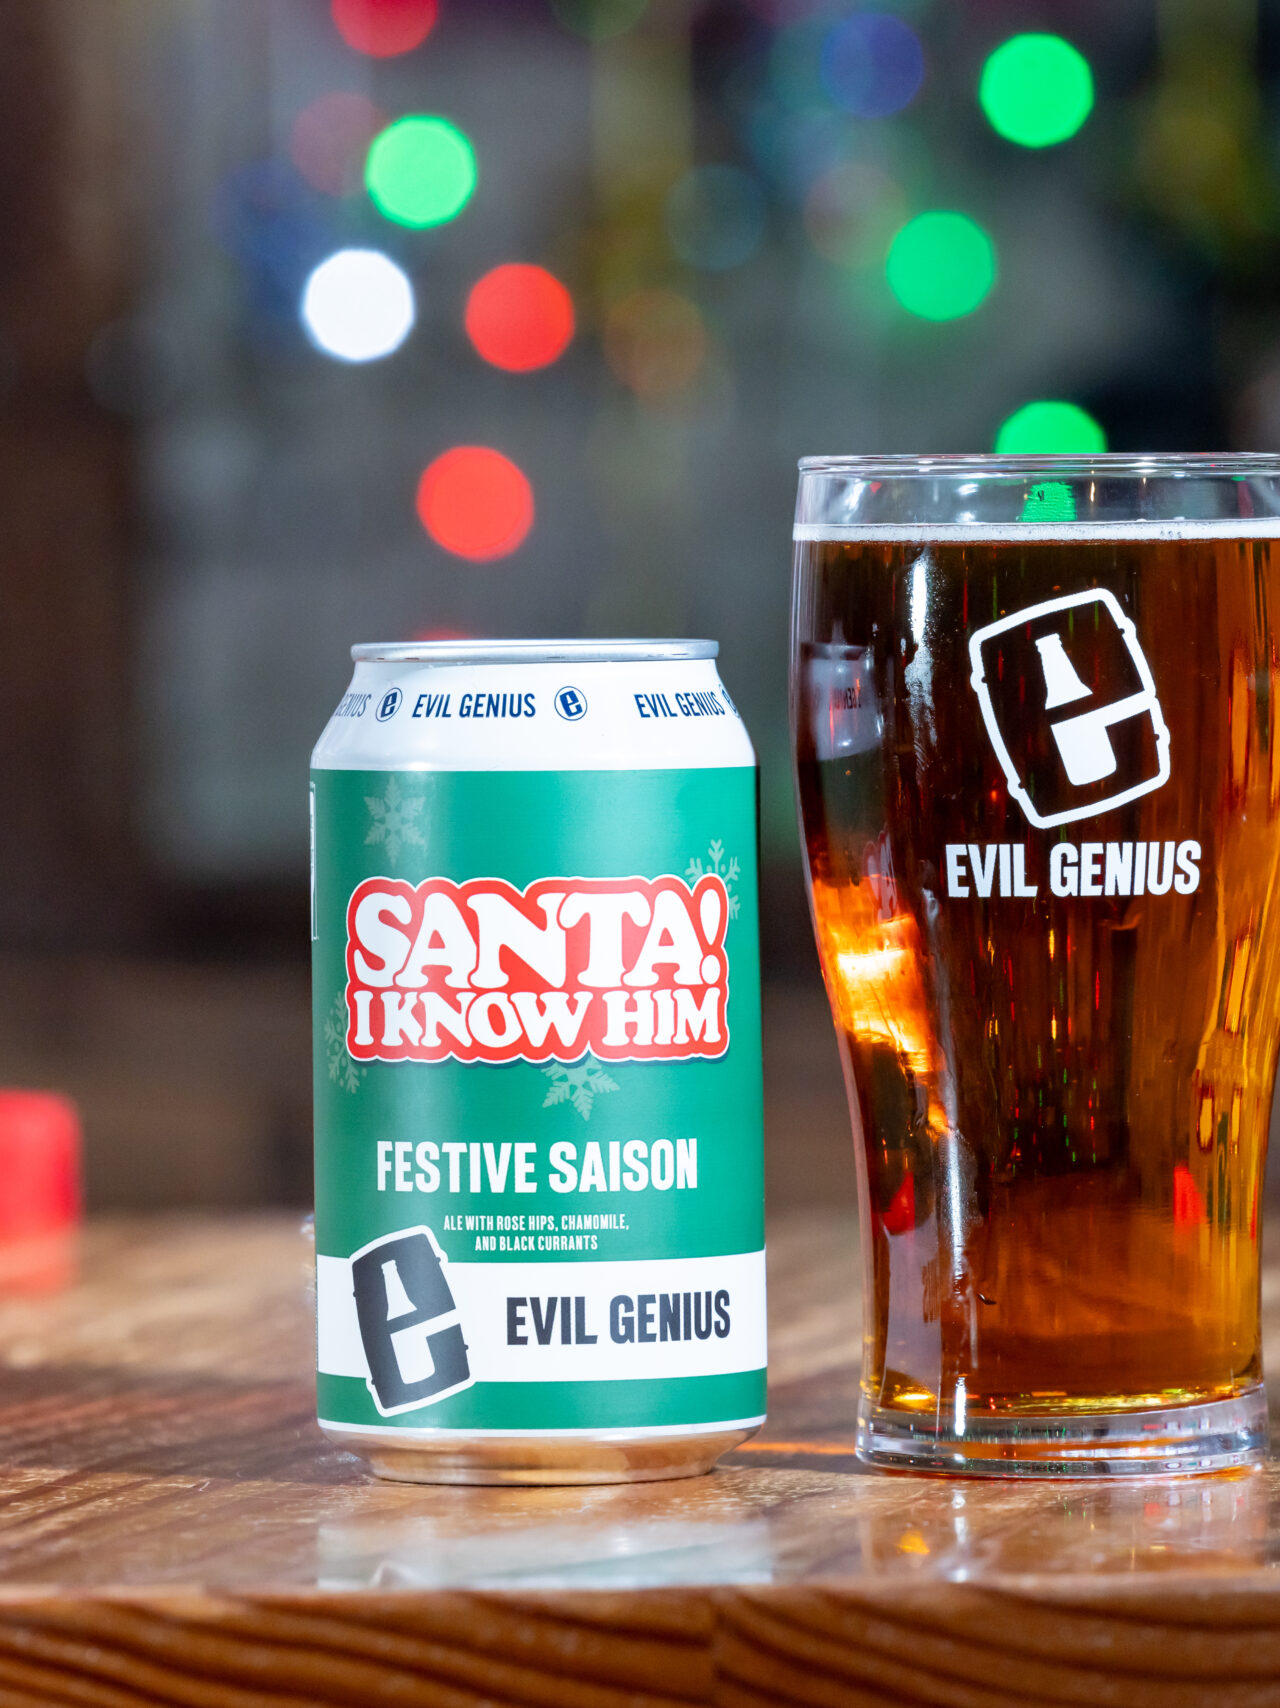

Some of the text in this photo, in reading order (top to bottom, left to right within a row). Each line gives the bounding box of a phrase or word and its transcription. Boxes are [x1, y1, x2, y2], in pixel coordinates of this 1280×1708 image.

[412, 693, 452, 718] EVIL
[459, 692, 536, 718] GENIUS
[633, 693, 678, 718] EVIL
[674, 691, 726, 717] GENIUS
[945, 839, 1202, 898] EVIL GENIUS
[353, 888, 722, 989] SANTA!
[353, 988, 722, 1048] I KNOW HIM
[376, 1138, 698, 1194] FESTIVE SAISON
[443, 1213, 630, 1232] ALE WITH ROSE HIPS, CHAMOMILE,
[474, 1234, 598, 1251] AND BLACK CURRANTS
[506, 1288, 731, 1346] EVIL GENIUS
